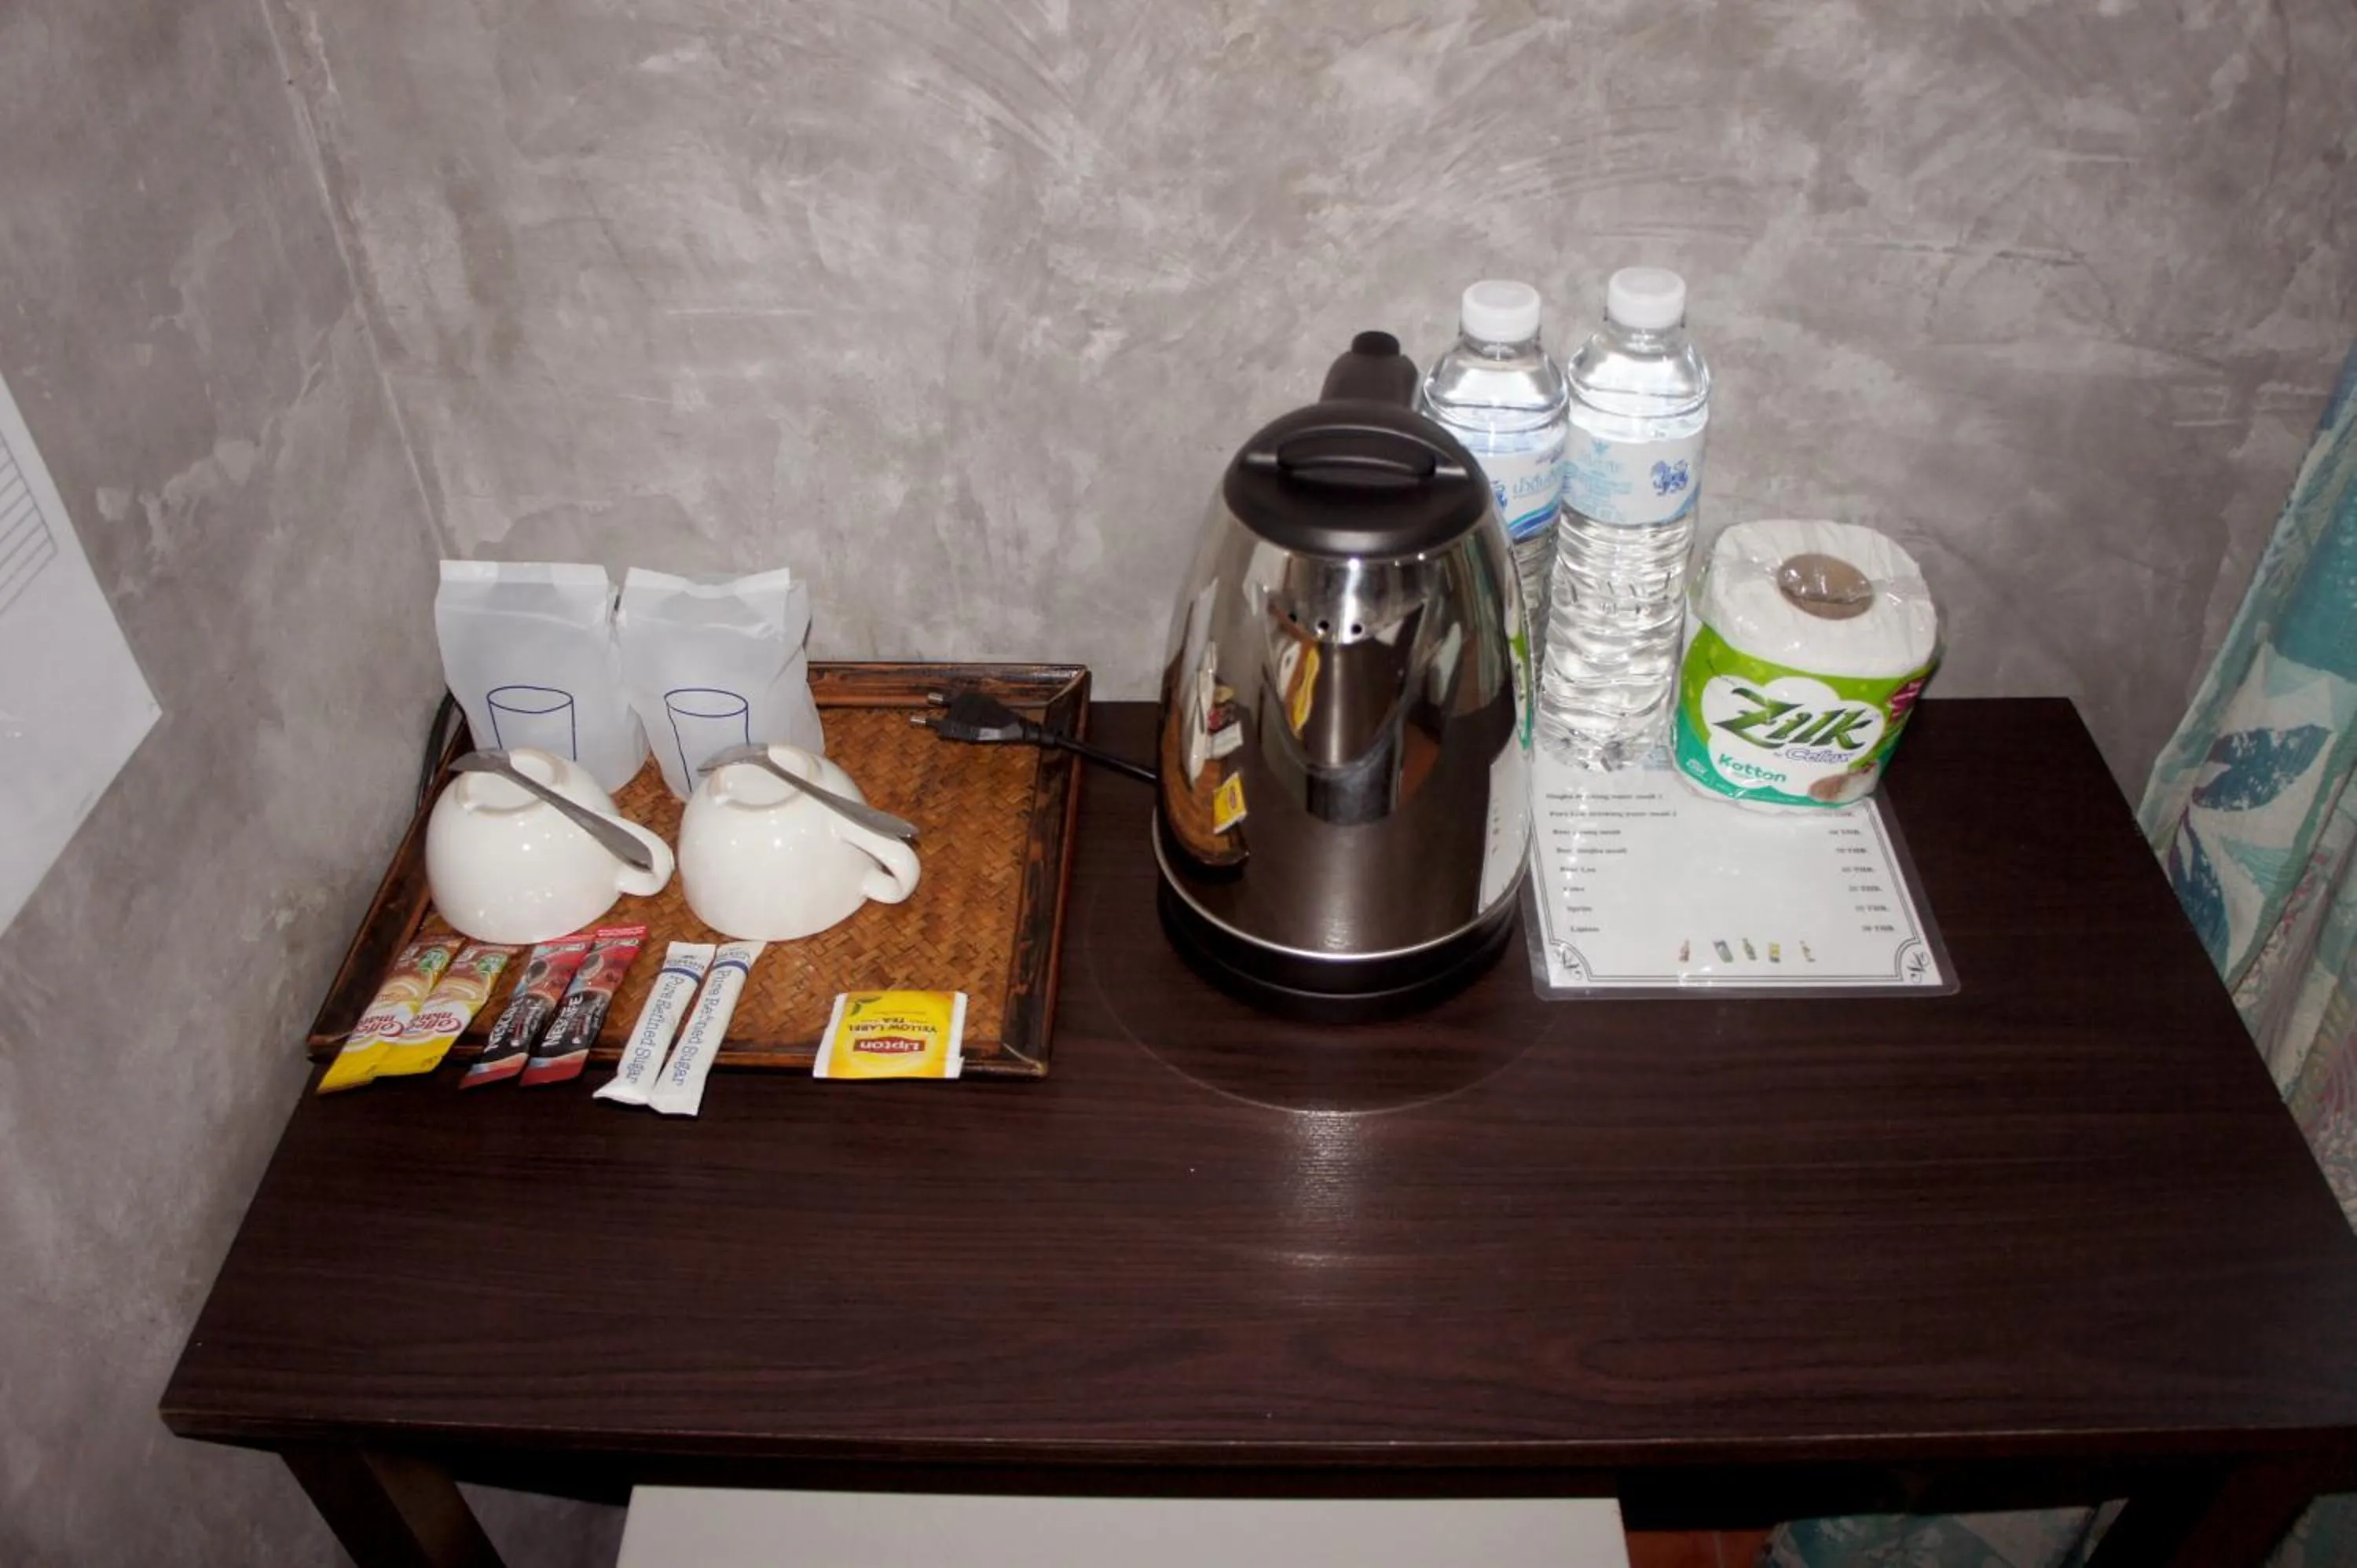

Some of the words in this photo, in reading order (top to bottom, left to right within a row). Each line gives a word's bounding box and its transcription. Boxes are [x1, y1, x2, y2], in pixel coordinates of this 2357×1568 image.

[1718, 753, 1787, 783] Kotton
[887, 1024, 937, 1034] YELLOW
[859, 1039, 920, 1051] Lipton
